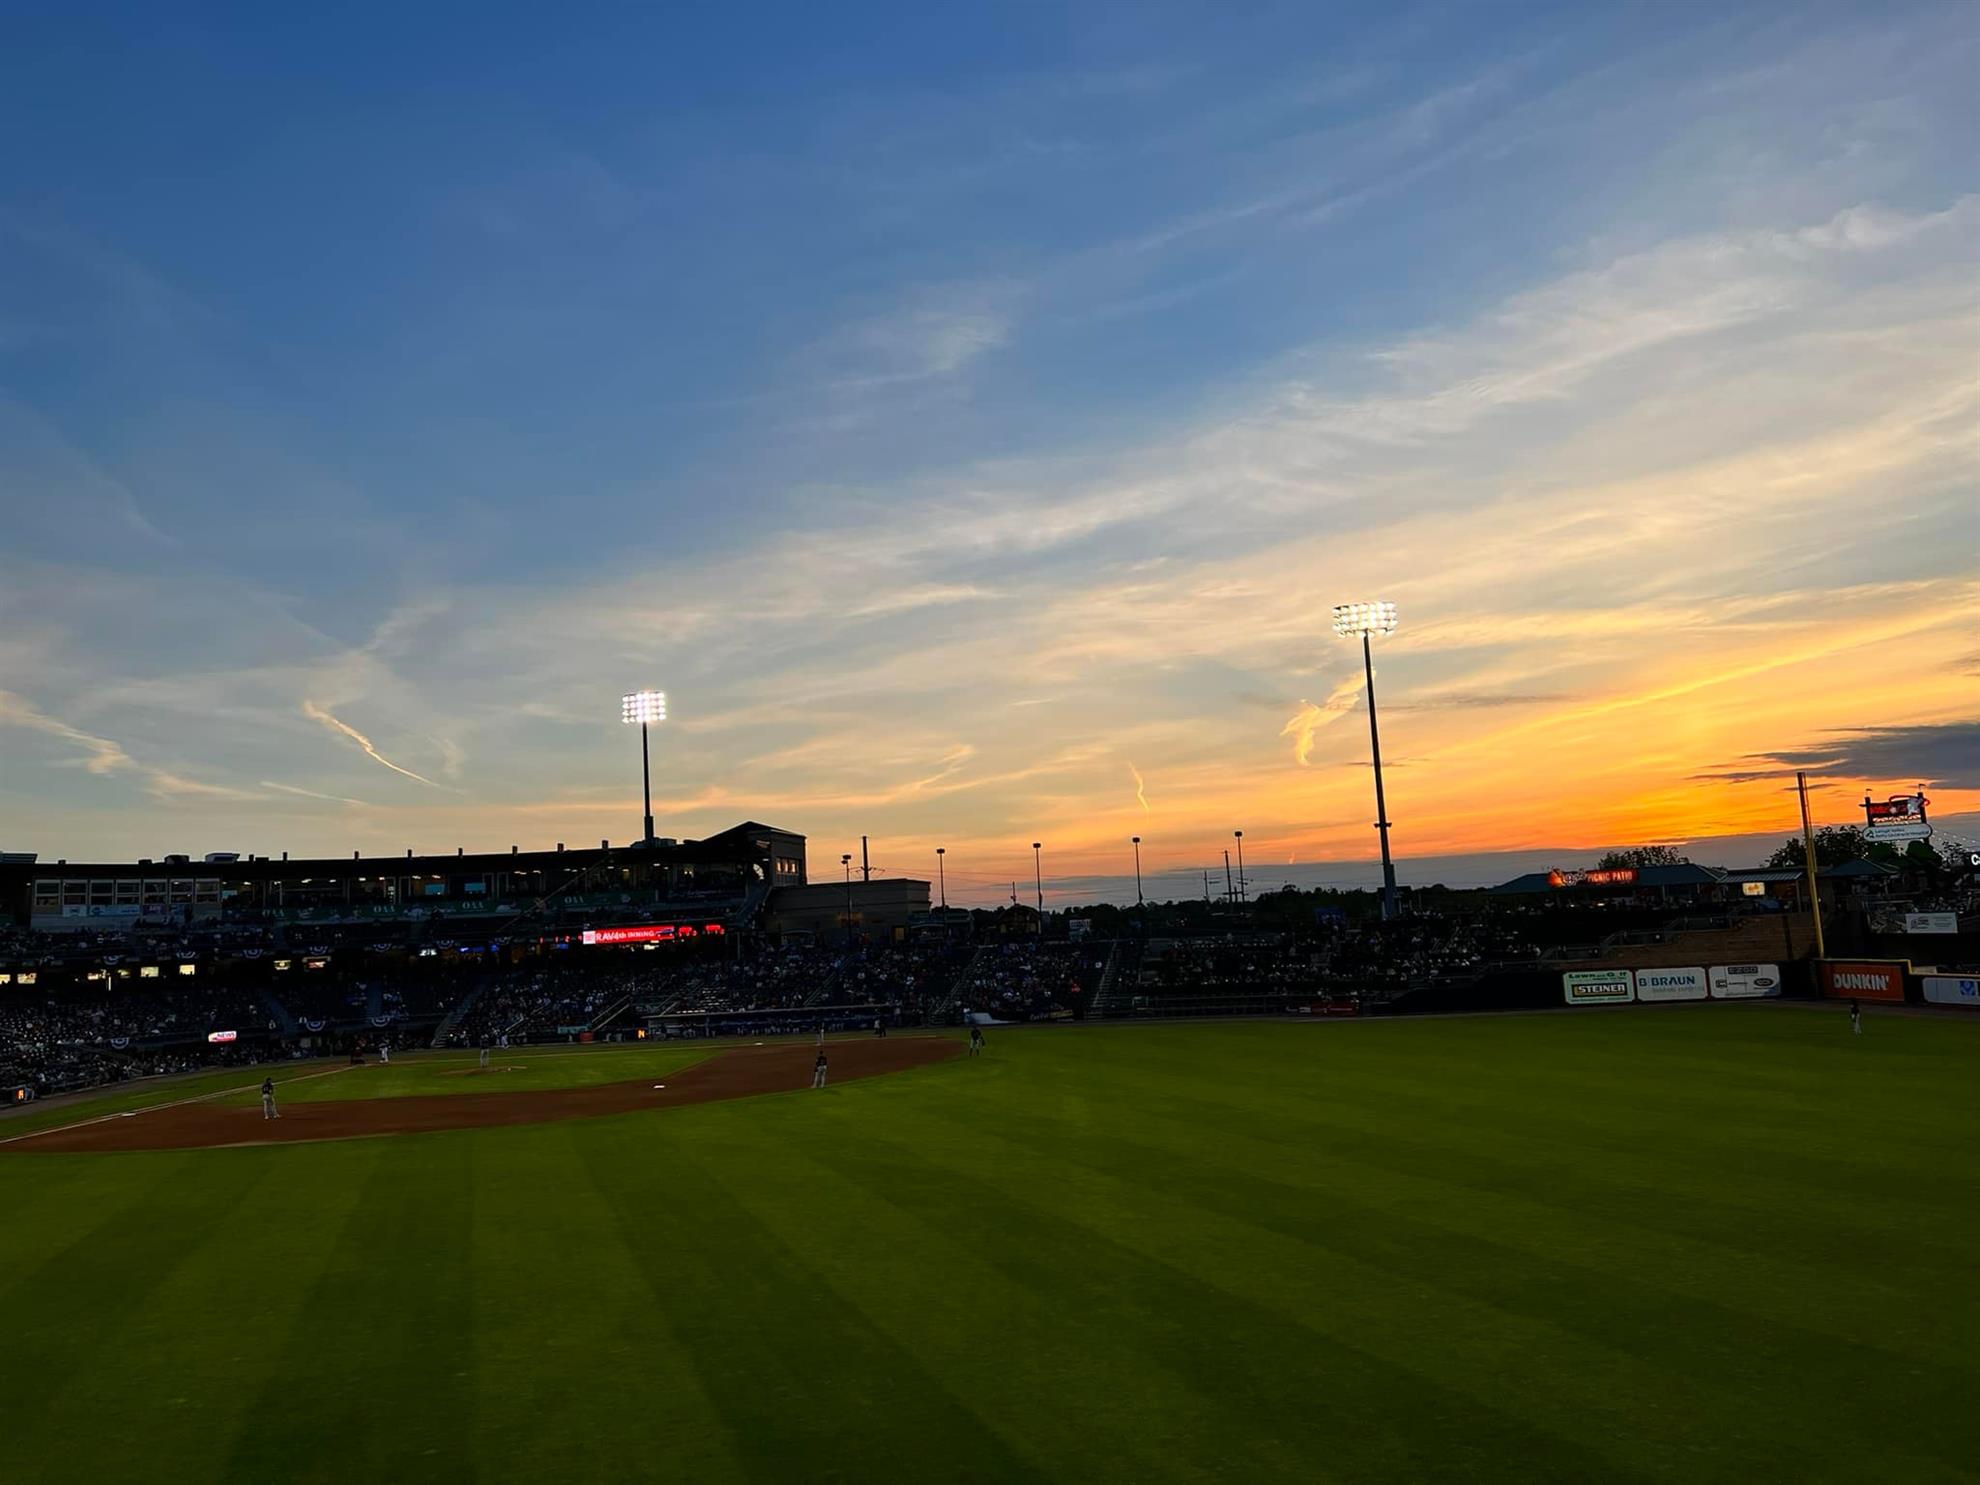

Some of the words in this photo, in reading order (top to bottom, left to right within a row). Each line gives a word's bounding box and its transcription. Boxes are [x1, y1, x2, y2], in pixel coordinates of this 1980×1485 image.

[1587, 872, 1610, 883] PICNIC
[1612, 871, 1633, 881] PATIO
[1651, 975, 1695, 986] BRAUN
[1833, 973, 1889, 991] DUNKIN'
[1578, 984, 1626, 994] STEINER
